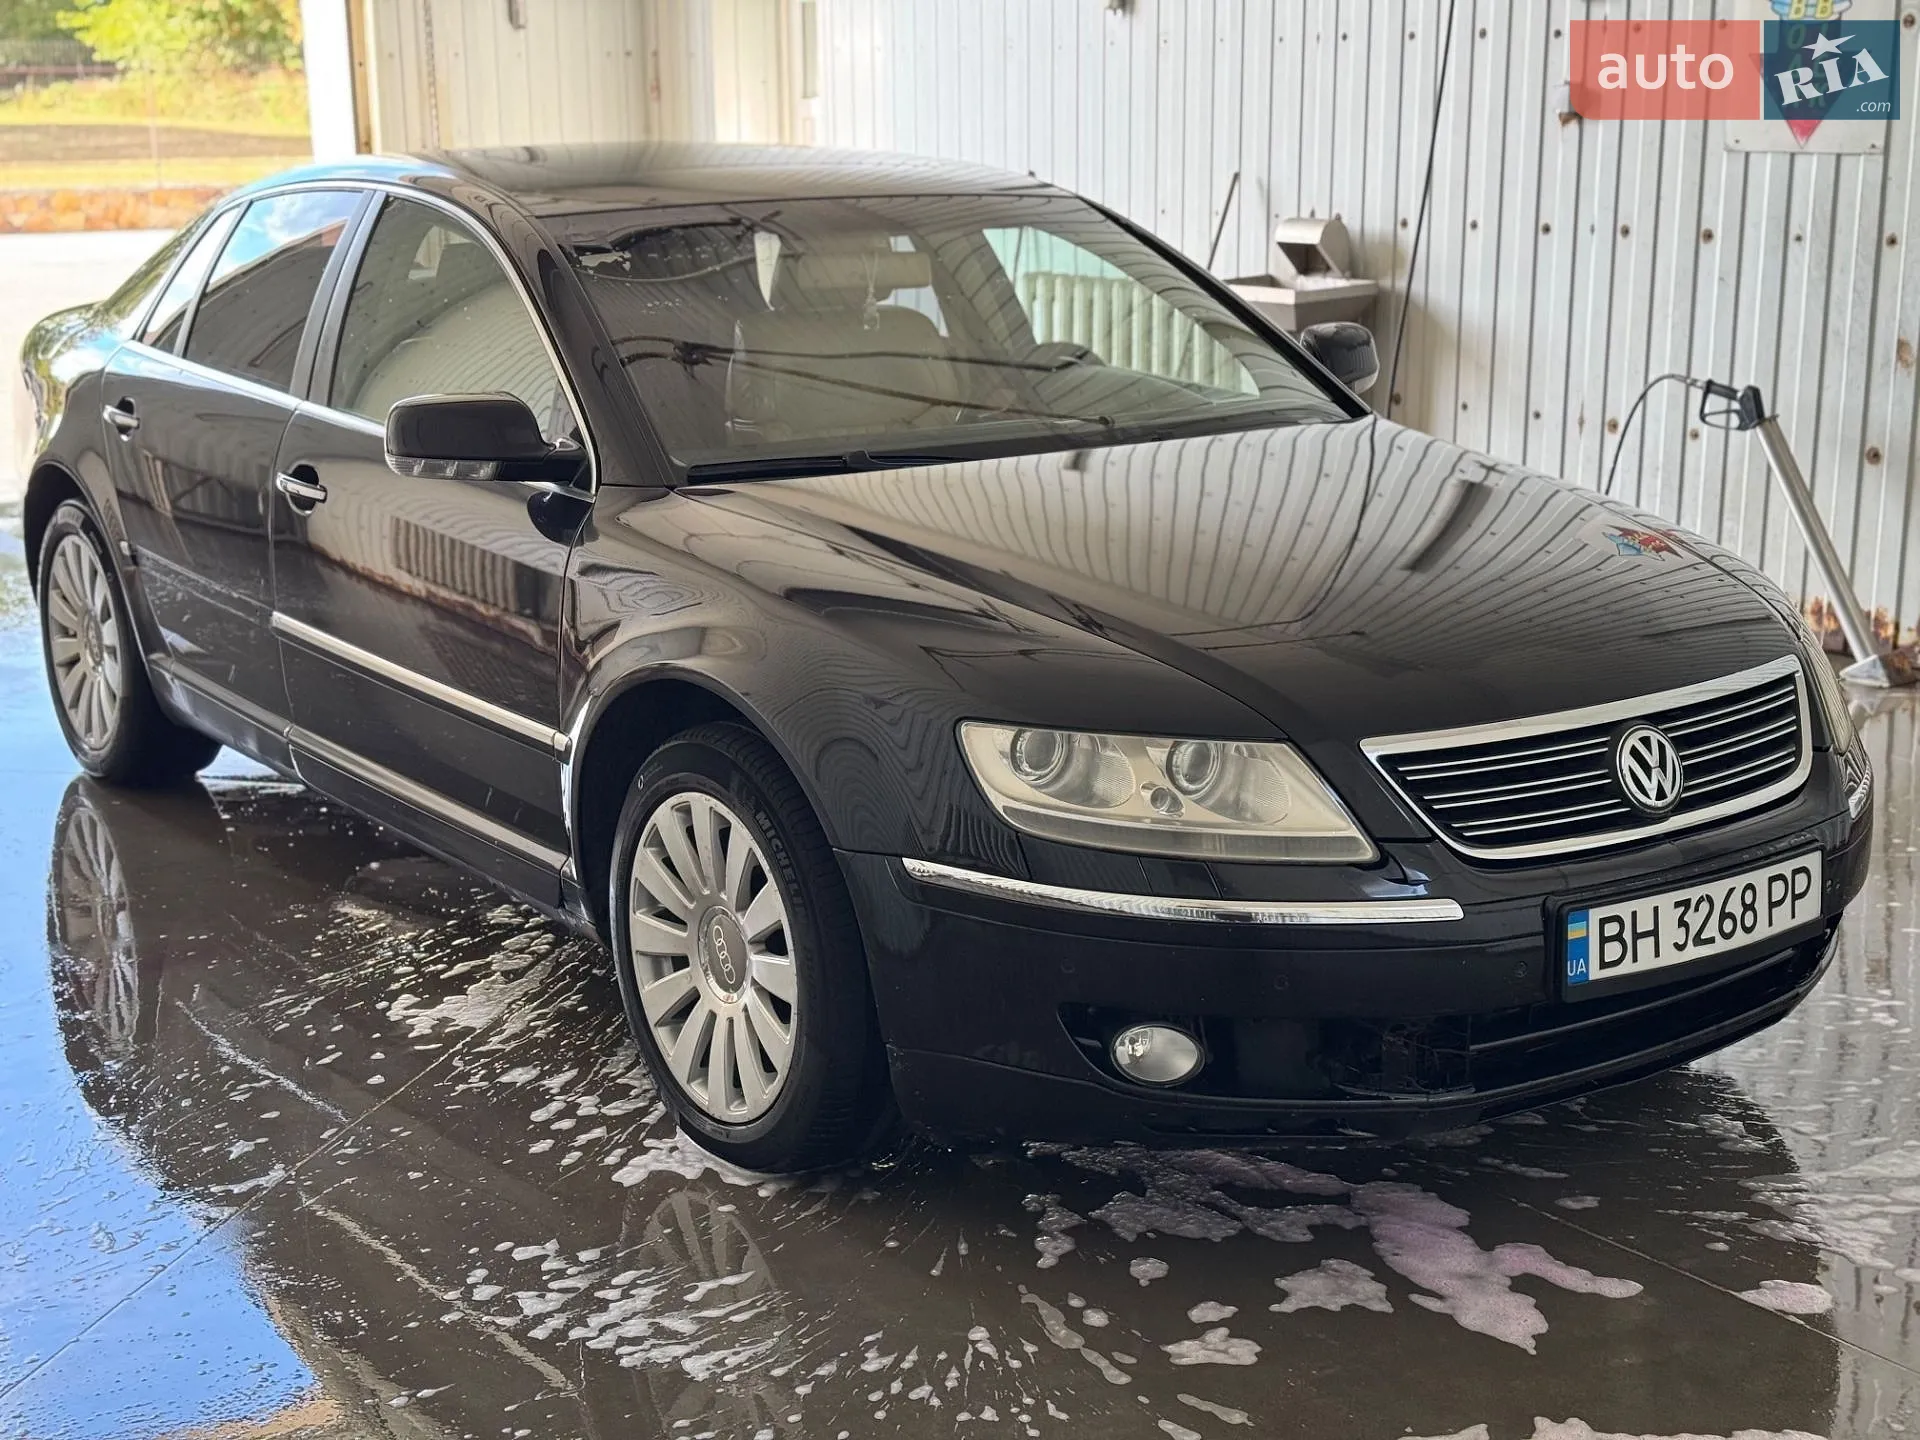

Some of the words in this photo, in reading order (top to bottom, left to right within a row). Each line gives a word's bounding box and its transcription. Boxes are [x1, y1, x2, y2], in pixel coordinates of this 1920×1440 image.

[1598, 905, 1661, 971] BH
[1672, 882, 1758, 952] 3268
[1767, 865, 1812, 928] PP
[1567, 959, 1587, 977] UA
